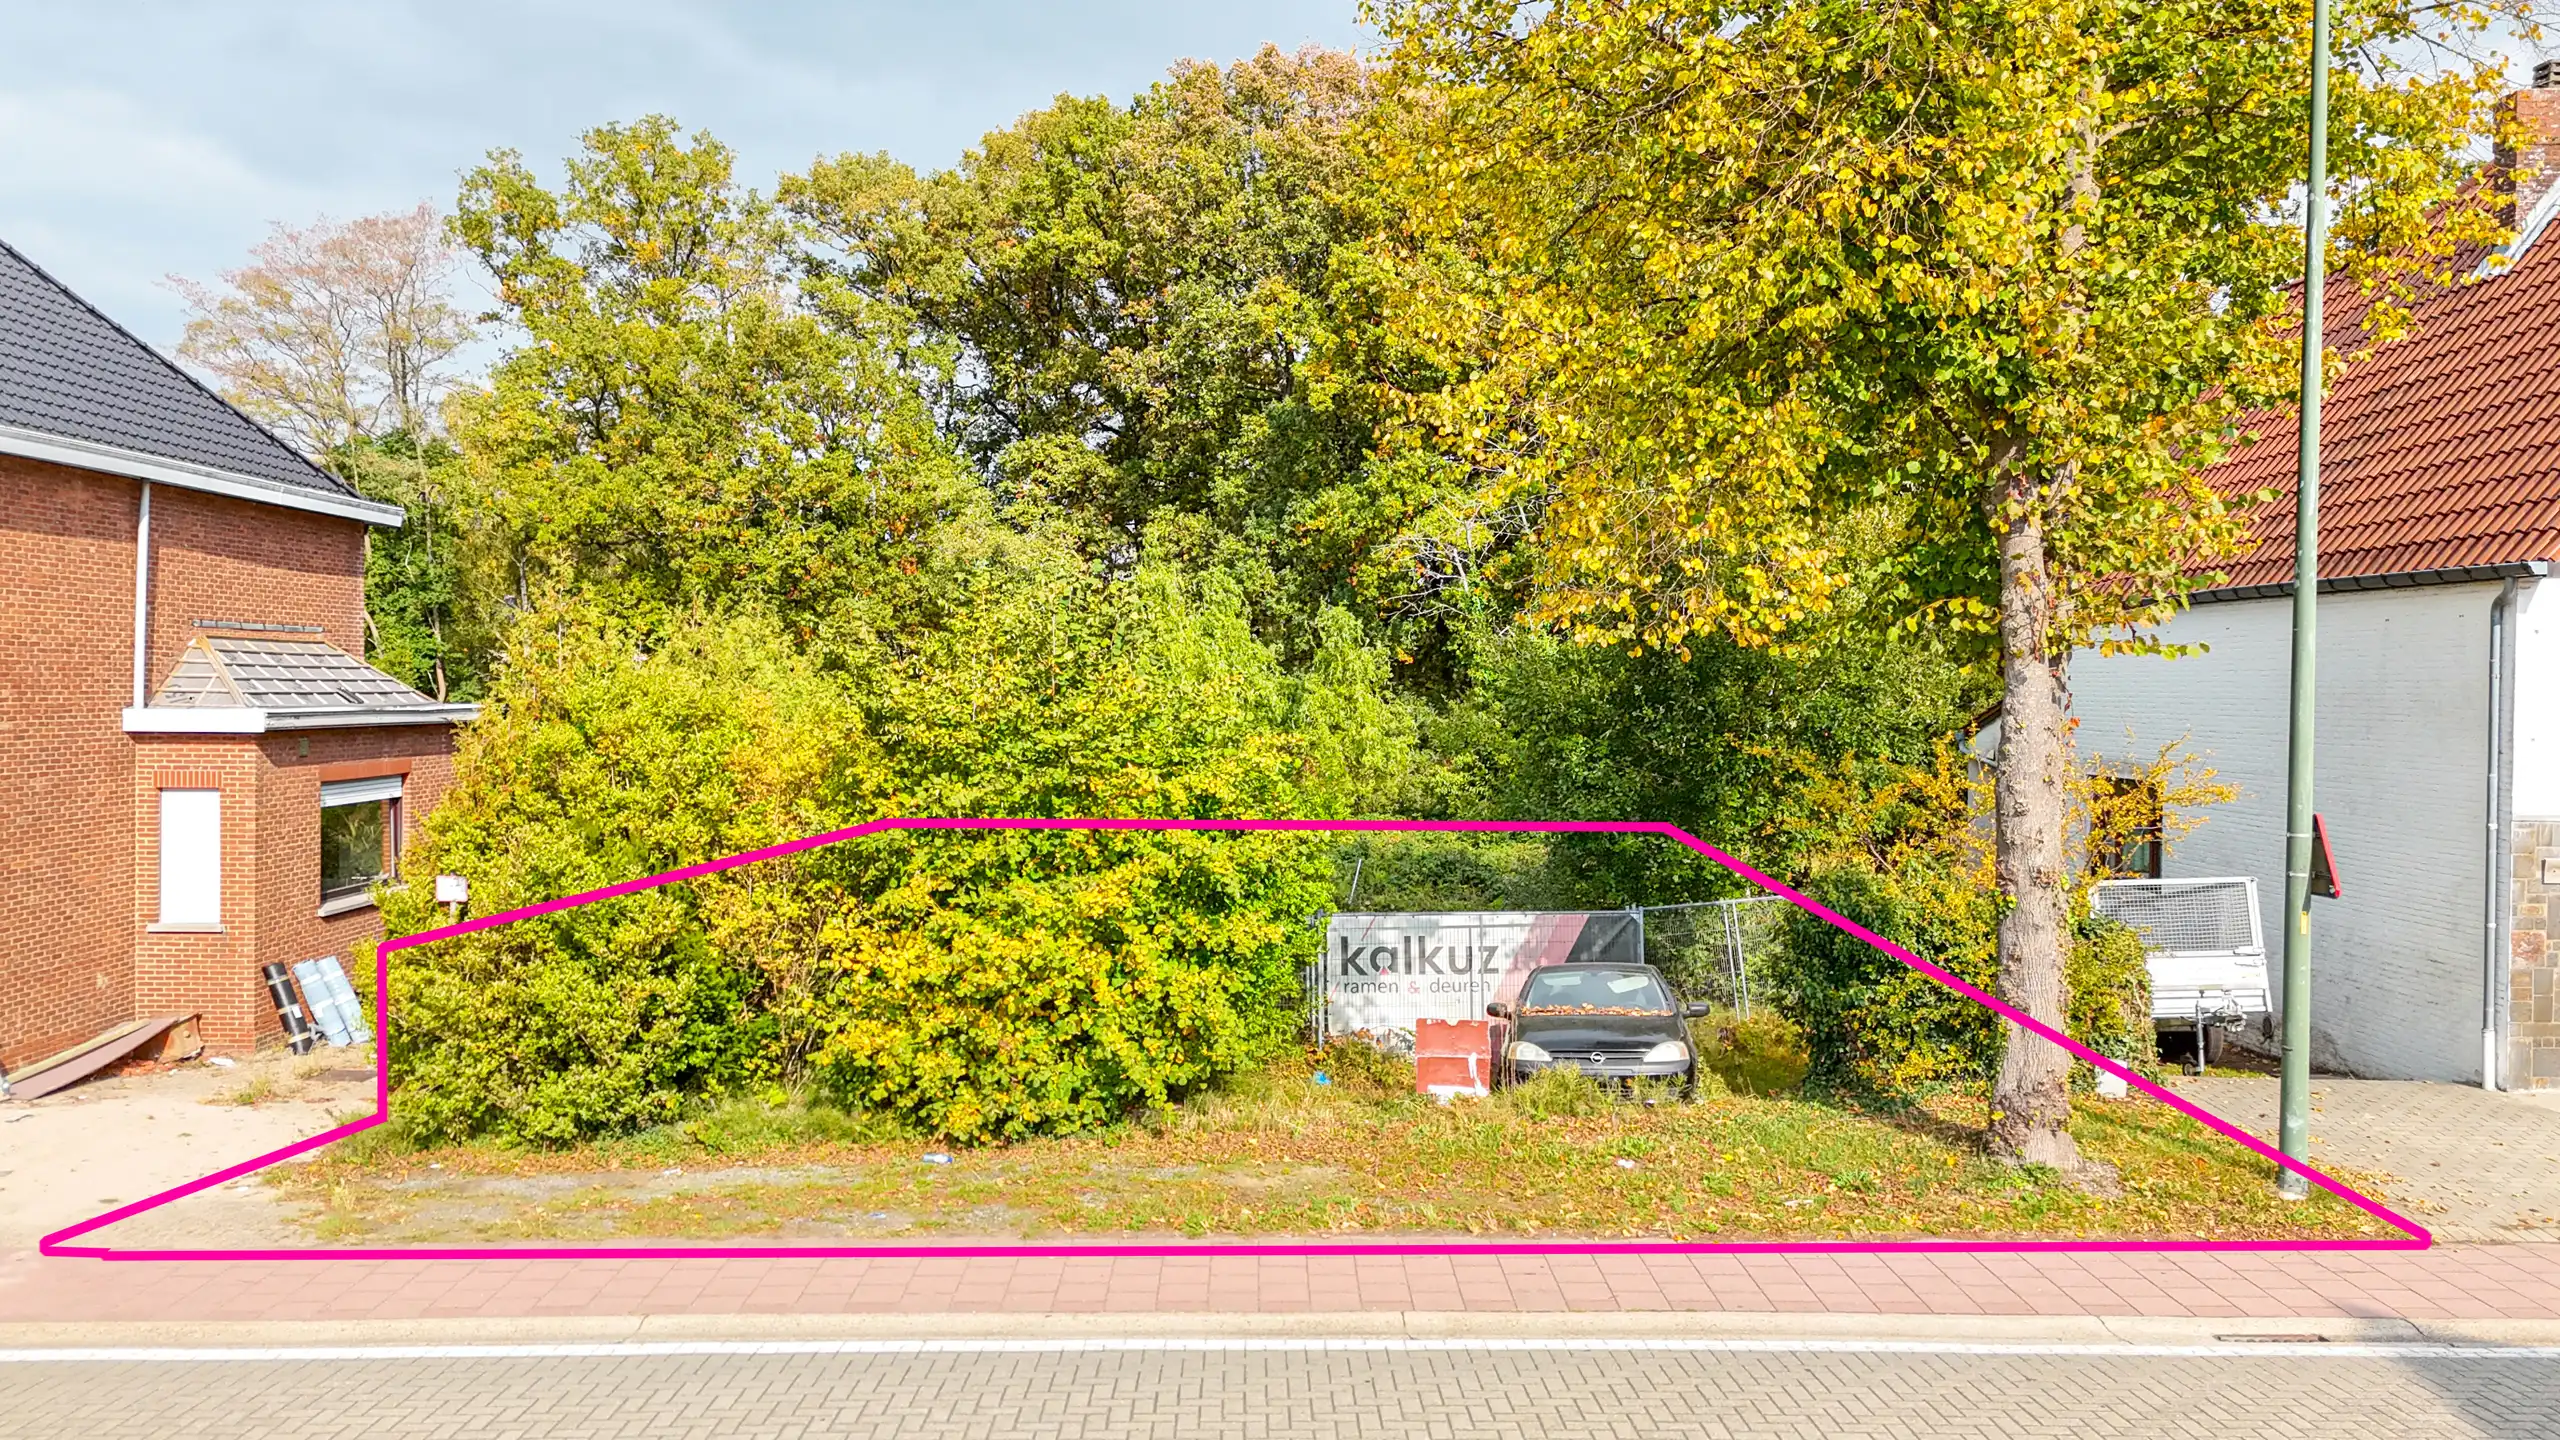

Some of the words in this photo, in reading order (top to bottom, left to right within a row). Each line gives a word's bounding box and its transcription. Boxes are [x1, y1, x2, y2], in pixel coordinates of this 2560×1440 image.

[1341, 936, 1499, 976] kalkuz
[1344, 981, 1399, 994] ramen
[1407, 981, 1420, 994] &
[1429, 977, 1491, 993] deuren
